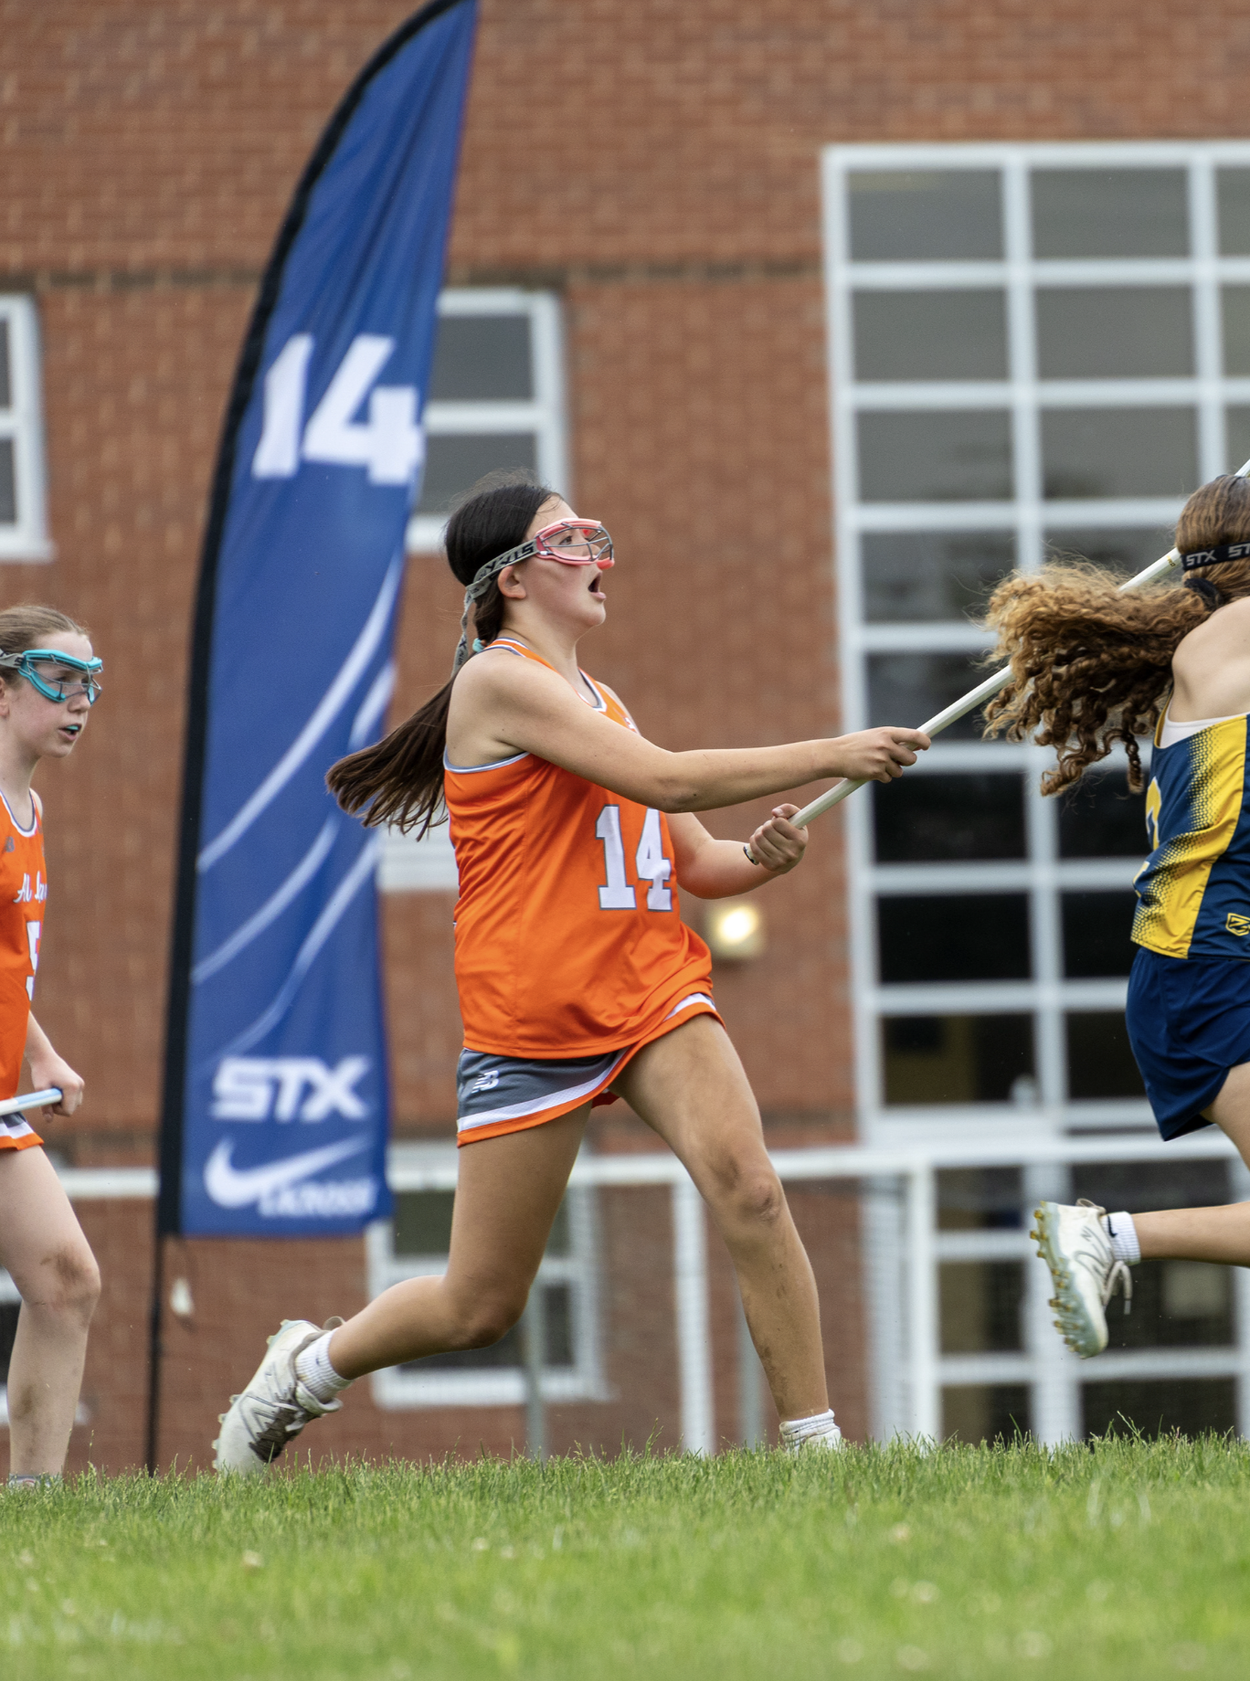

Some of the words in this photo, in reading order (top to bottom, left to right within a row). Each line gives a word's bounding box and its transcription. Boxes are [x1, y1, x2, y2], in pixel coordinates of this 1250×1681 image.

[252, 333, 426, 485] 14
[1186, 549, 1217, 566] STX
[595, 804, 673, 912] 14
[211, 1056, 370, 1122] STX
